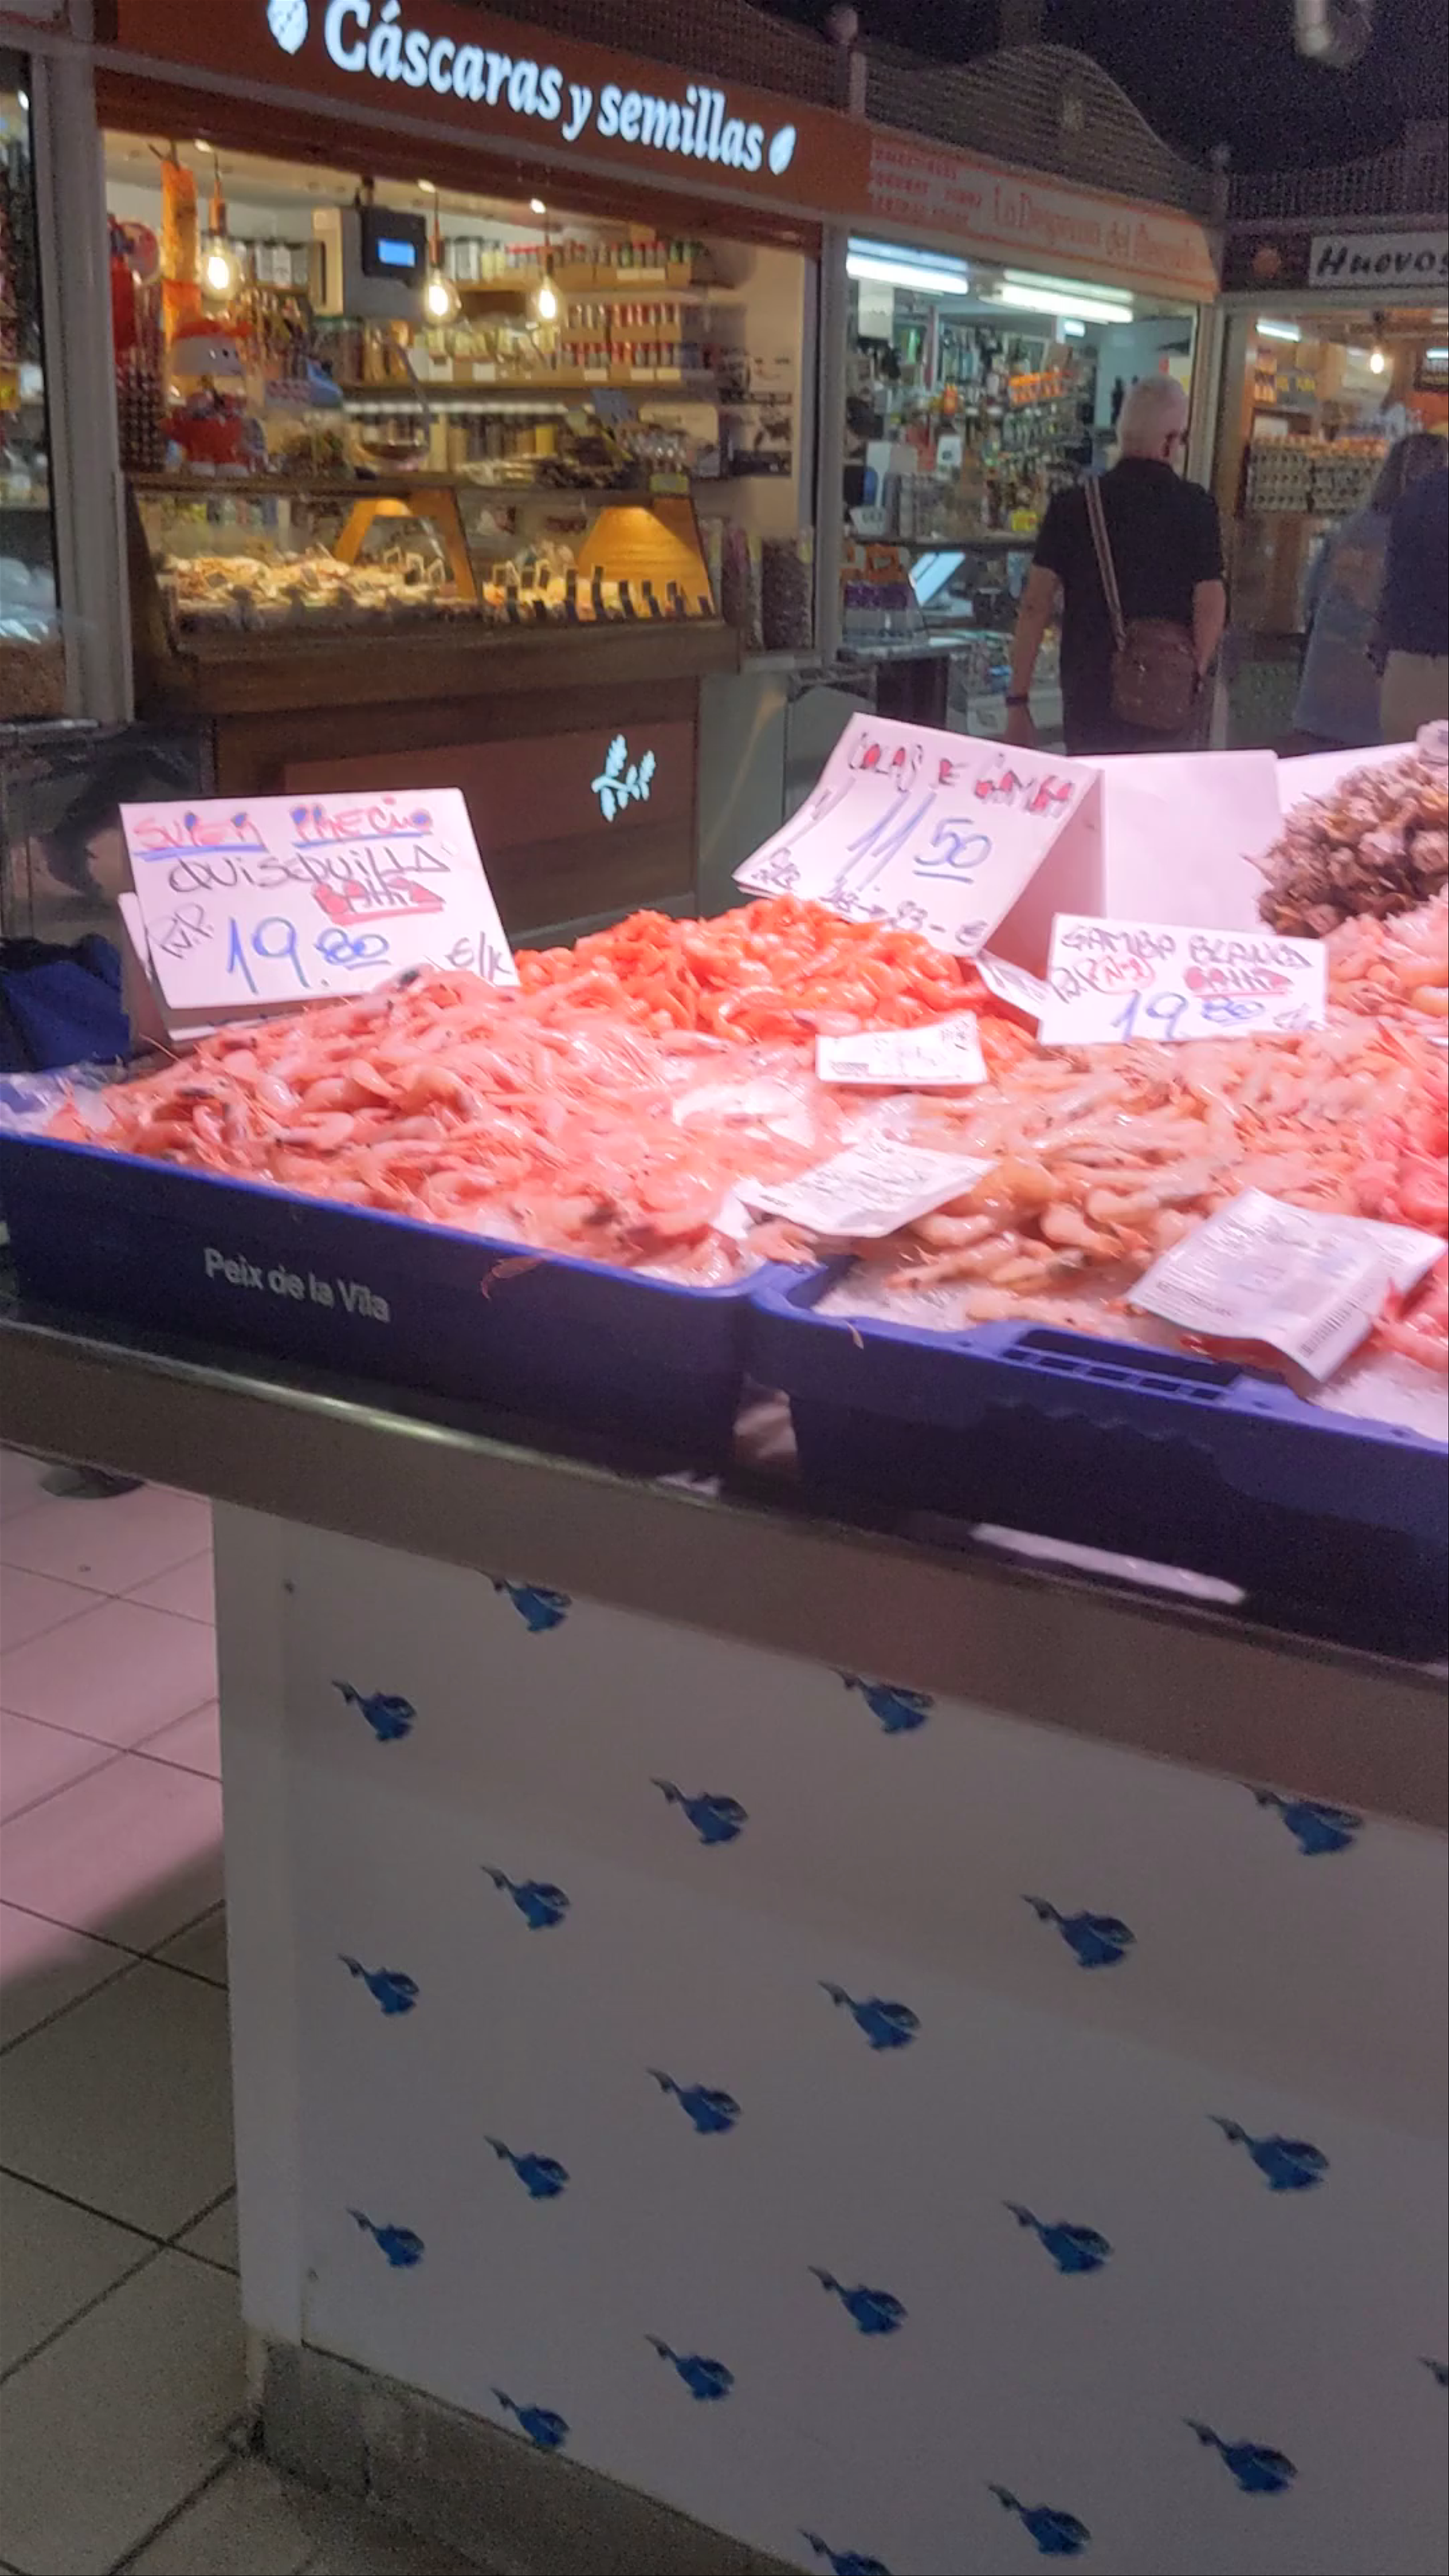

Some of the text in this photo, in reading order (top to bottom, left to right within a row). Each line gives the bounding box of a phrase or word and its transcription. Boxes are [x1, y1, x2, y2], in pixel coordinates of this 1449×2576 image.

[324, 0, 764, 172] Cáscaras y semillas
[204, 1247, 263, 1290] Peix
